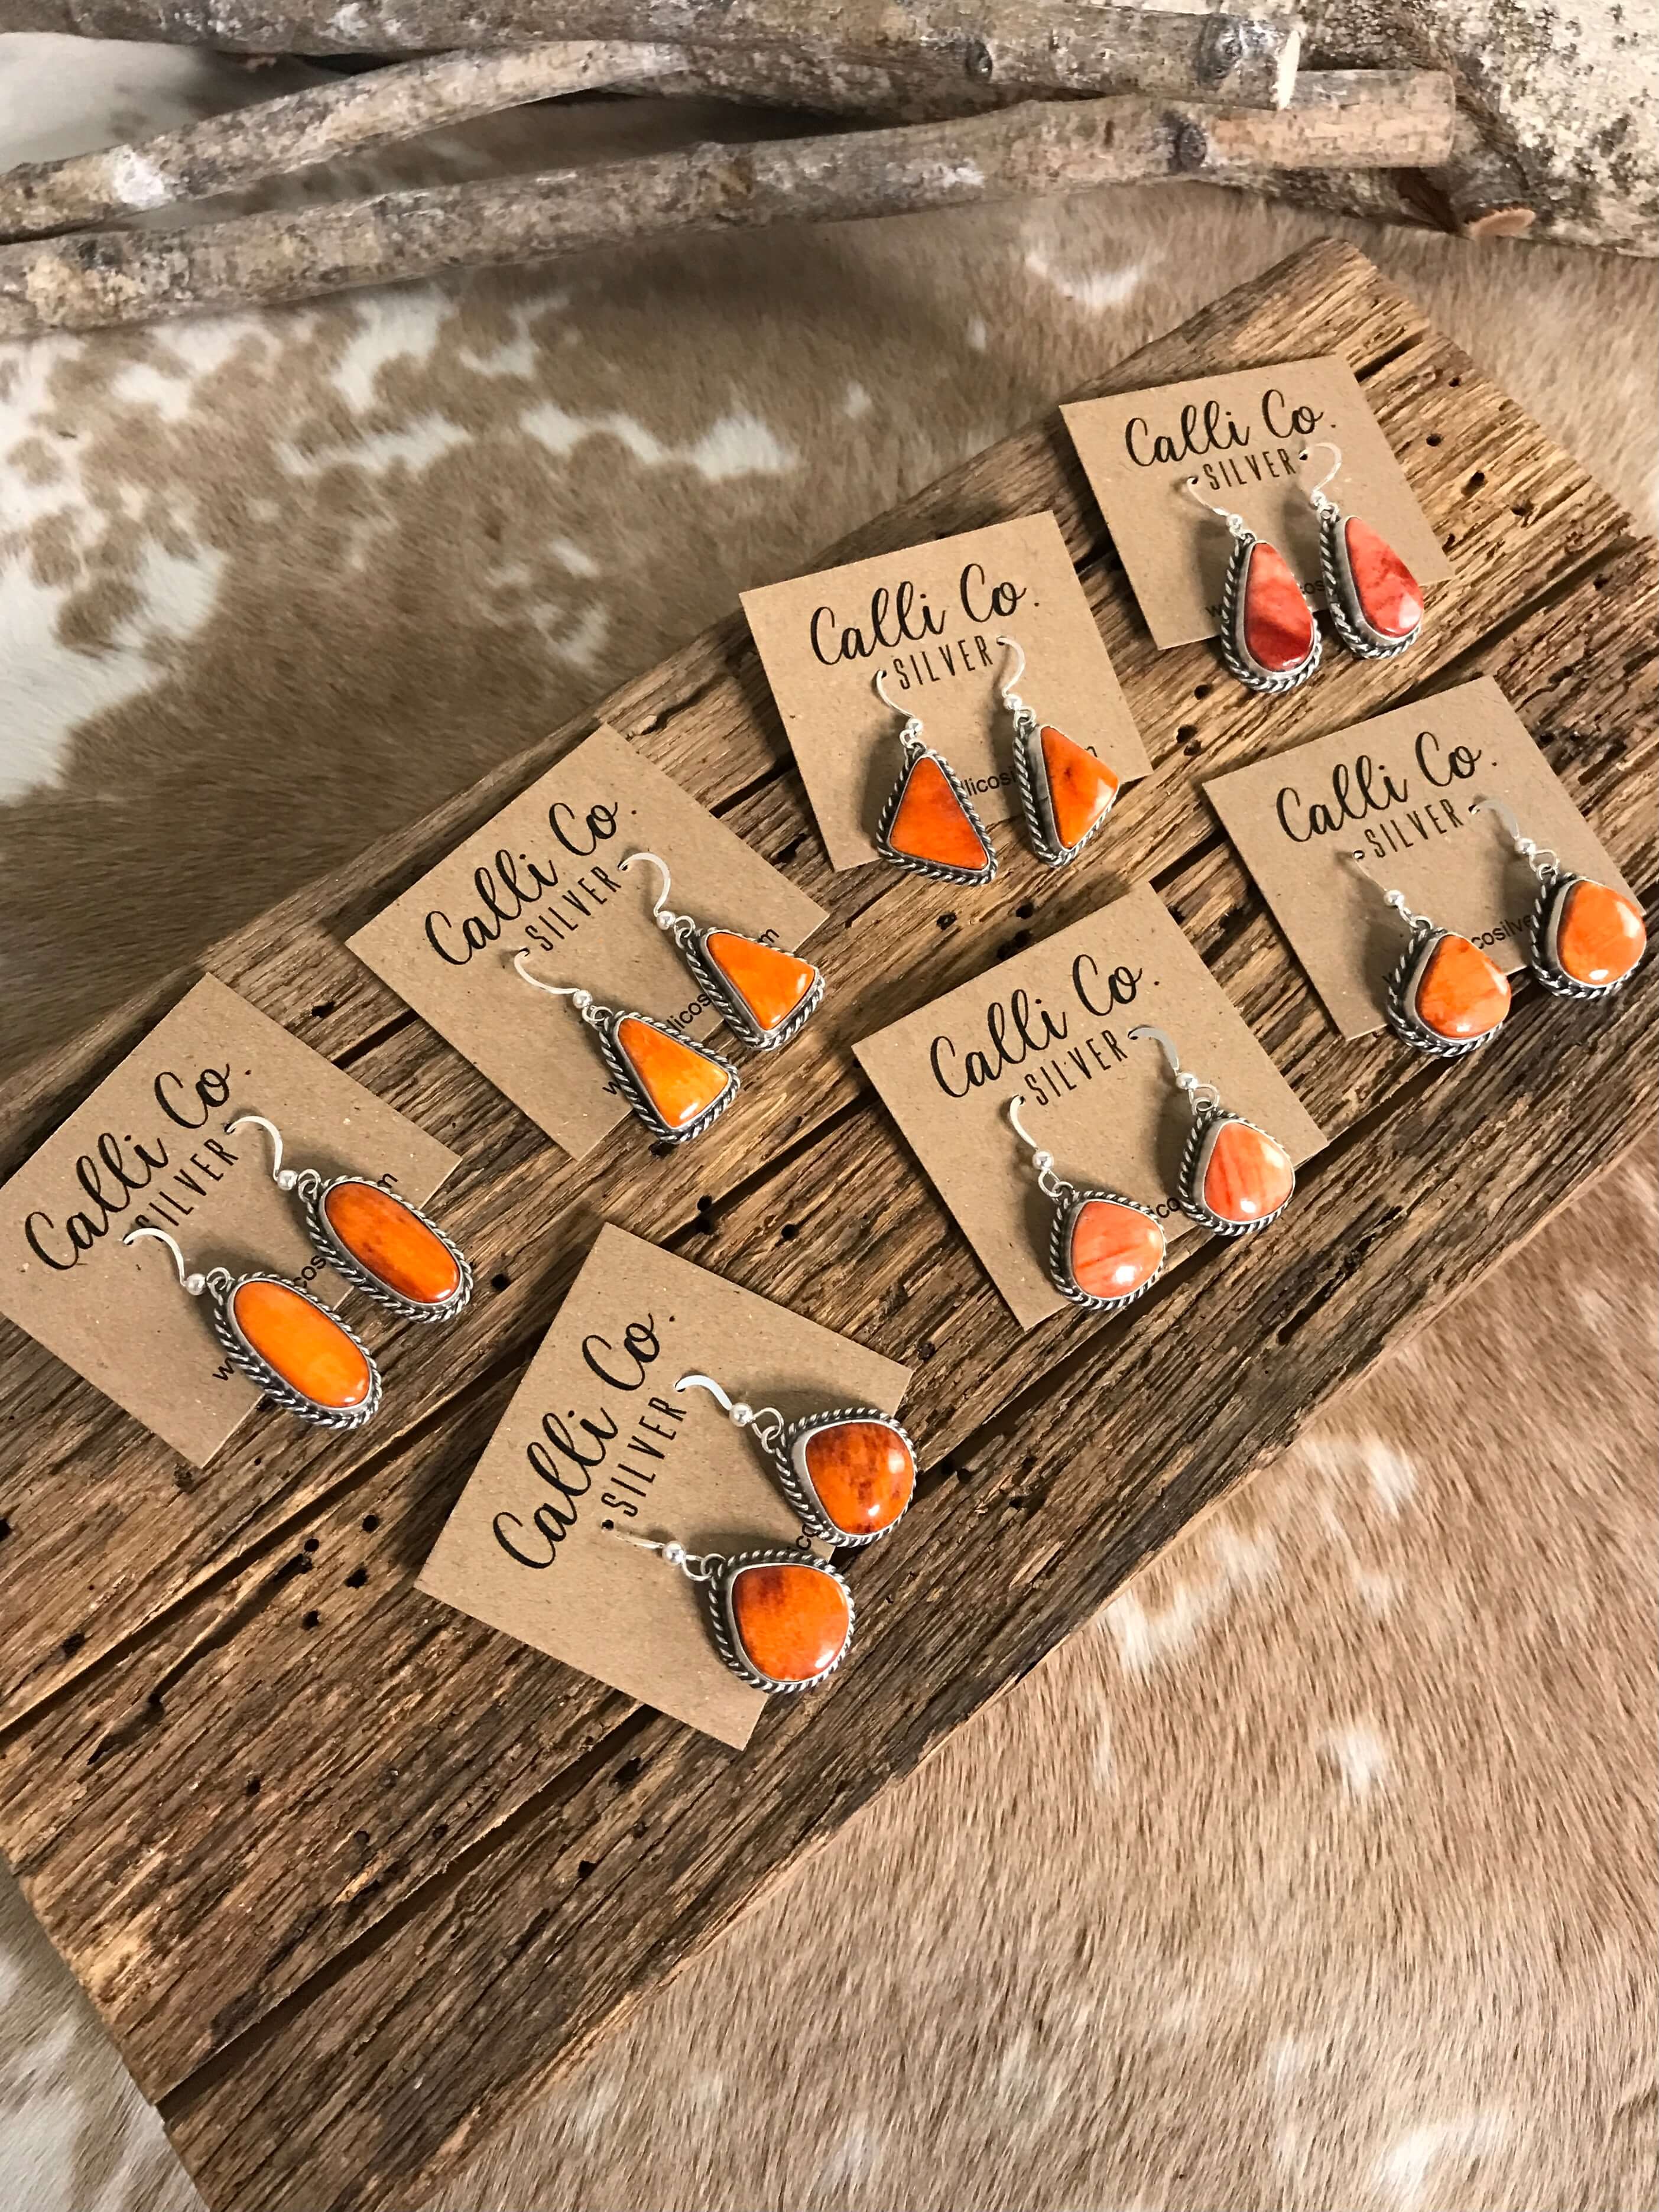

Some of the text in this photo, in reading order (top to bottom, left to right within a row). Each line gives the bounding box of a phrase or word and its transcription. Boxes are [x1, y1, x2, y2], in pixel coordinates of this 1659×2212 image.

[1126, 389, 1336, 466] Calli Co.
[1203, 449, 1296, 490] SILVER
[810, 563, 1040, 665] Calli Co.
[894, 635, 993, 690] SILVER
[1277, 732, 1497, 842] Calli Co.
[1365, 798, 1463, 859] SILVER
[424, 801, 638, 965] Calli Co.
[526, 866, 622, 951] SILVER
[930, 954, 1160, 1098] Calli Co.
[1024, 1029, 1128, 1106] SILVER
[25, 1064, 251, 1270] Calli Co.
[493, 1313, 676, 1570] Calli Co.
[601, 1396, 687, 1518] SILVER
